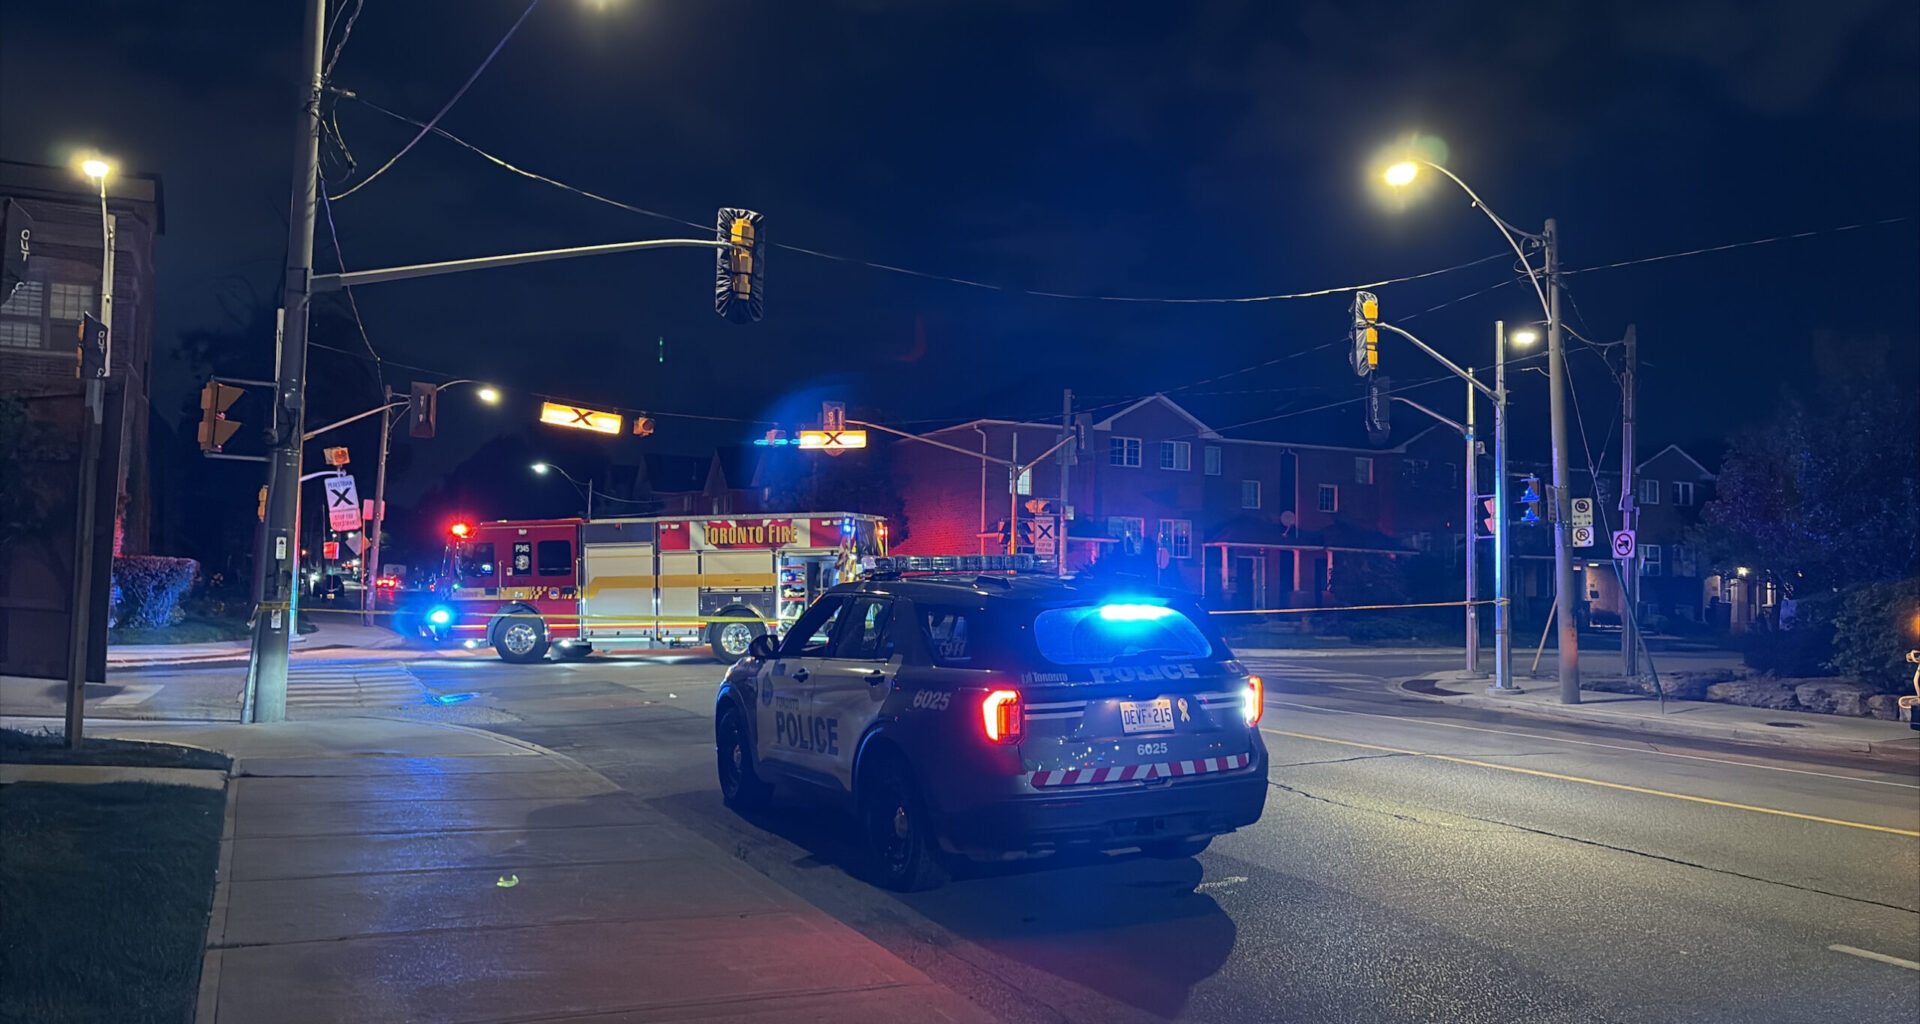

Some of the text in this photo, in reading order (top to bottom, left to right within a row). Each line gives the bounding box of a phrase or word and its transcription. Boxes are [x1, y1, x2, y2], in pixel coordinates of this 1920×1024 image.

[20, 229, 31, 262] OUT
[703, 524, 798, 545] TORONTO FIRE
[1089, 663, 1200, 684] POLICE
[913, 689, 952, 711] 6025
[1152, 708, 1171, 723] 215
[776, 711, 839, 756] POLICE
[1137, 742, 1168, 756] 6025
